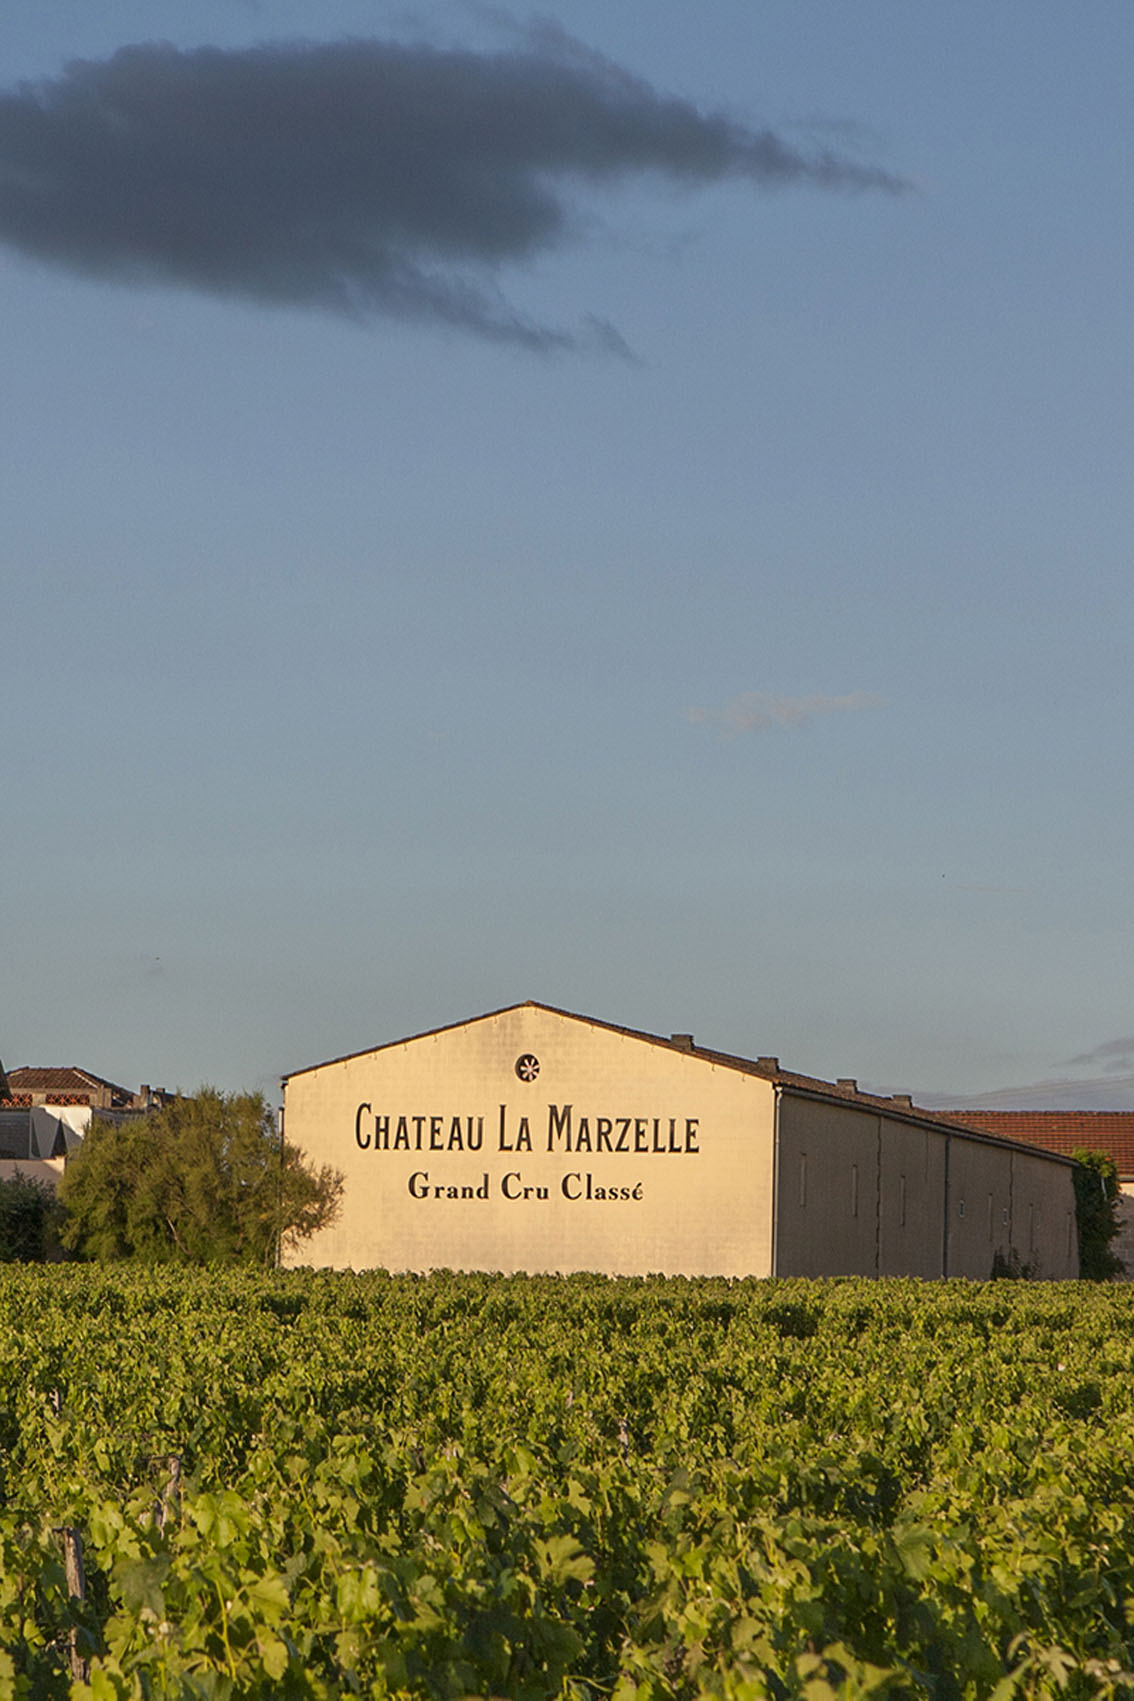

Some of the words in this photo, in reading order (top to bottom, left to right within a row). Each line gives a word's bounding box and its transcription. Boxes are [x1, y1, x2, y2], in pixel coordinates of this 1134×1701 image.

[355, 1102, 484, 1152] CHATEAU
[498, 1104, 533, 1152] LA
[546, 1104, 700, 1154] MARZELLE
[408, 1171, 489, 1200] Grand
[501, 1172, 549, 1200] Cru
[561, 1172, 644, 1201] Classé
